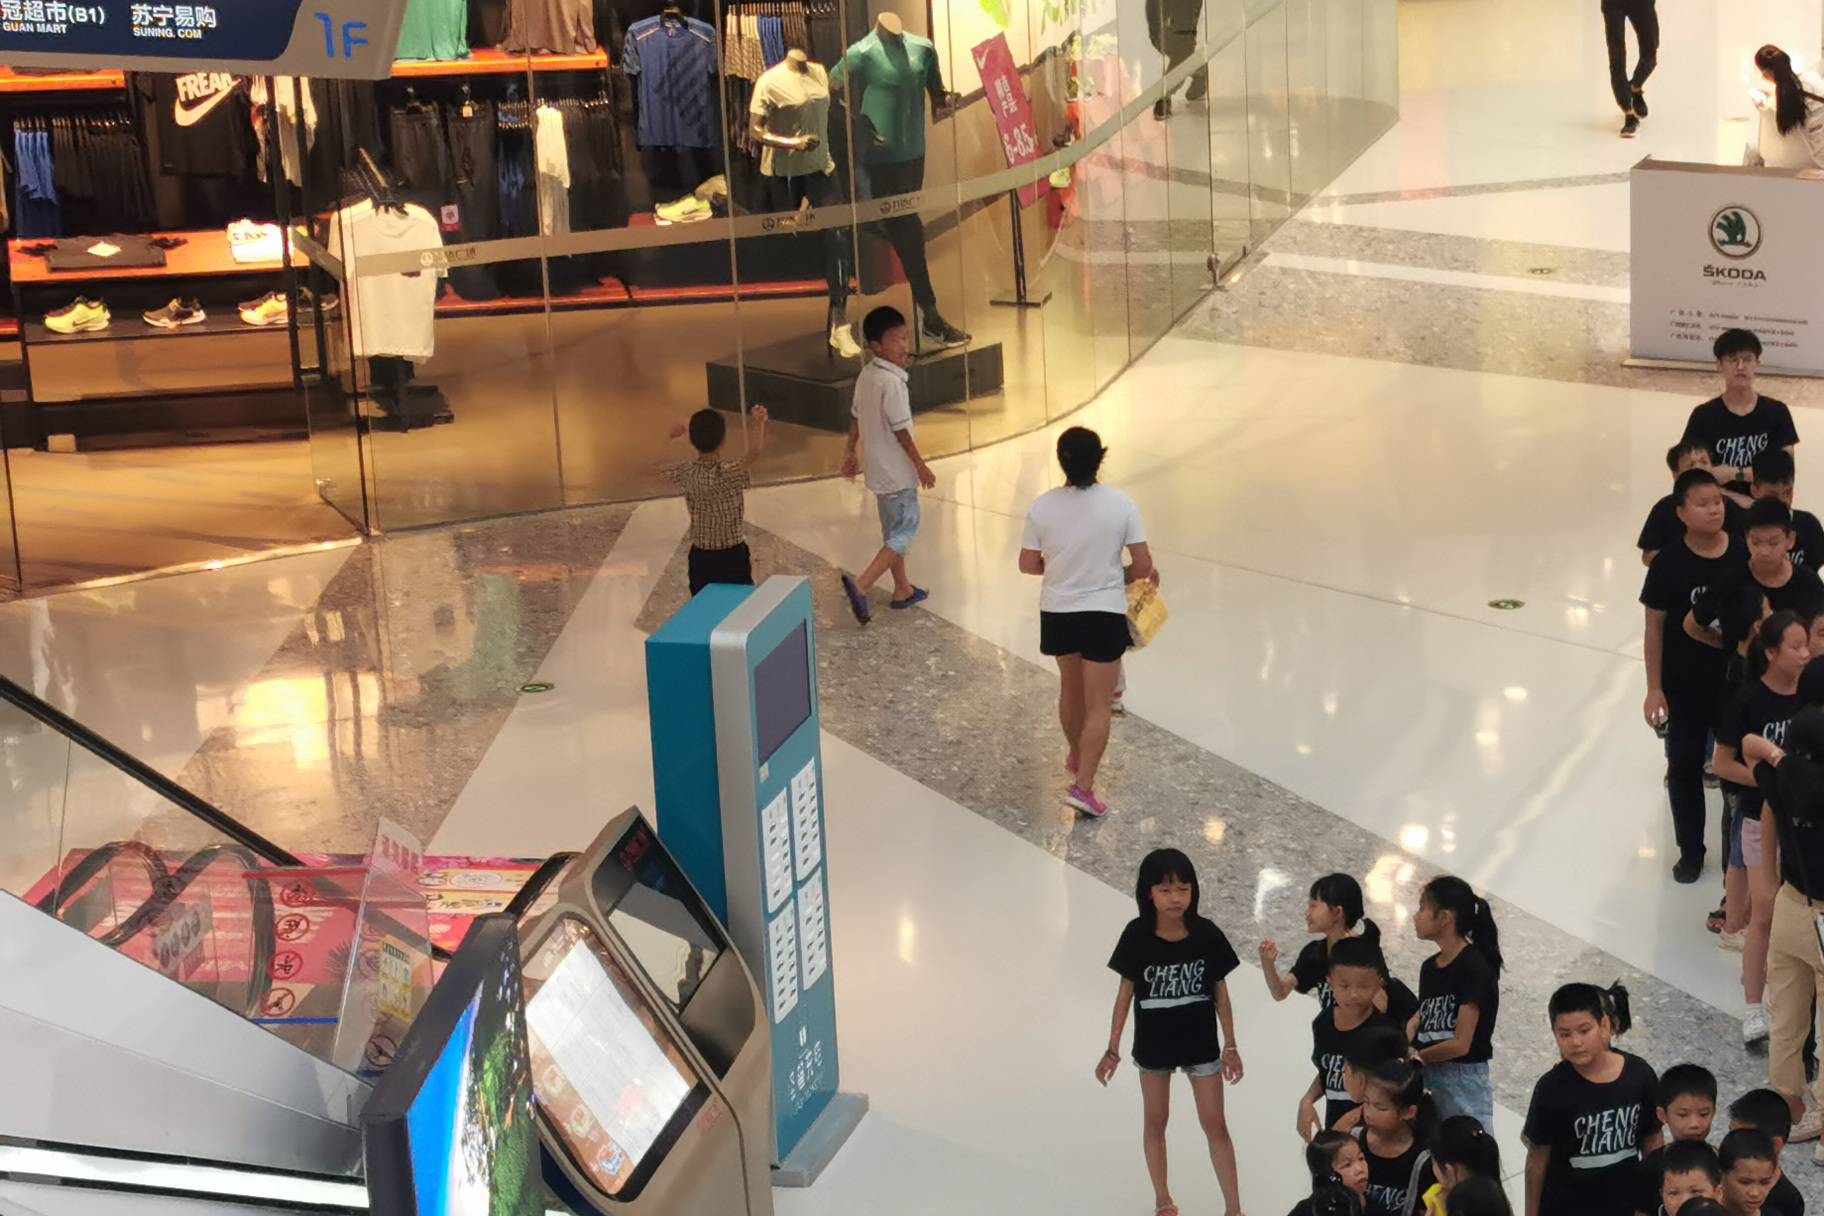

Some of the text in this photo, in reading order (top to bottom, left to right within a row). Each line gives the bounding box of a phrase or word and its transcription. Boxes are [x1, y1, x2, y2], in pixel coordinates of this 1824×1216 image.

[3, 22, 67, 34] GUAN MART
[131, 5, 217, 28] 苏宁易购
[315, 12, 369, 59] 1F
[1716, 432, 1769, 455] CHENG
[1143, 959, 1206, 984] CHENG
[1149, 976, 1204, 997] LIANG
[1573, 1103, 1641, 1140] CHENG
[1580, 1128, 1637, 1155] LIANG
